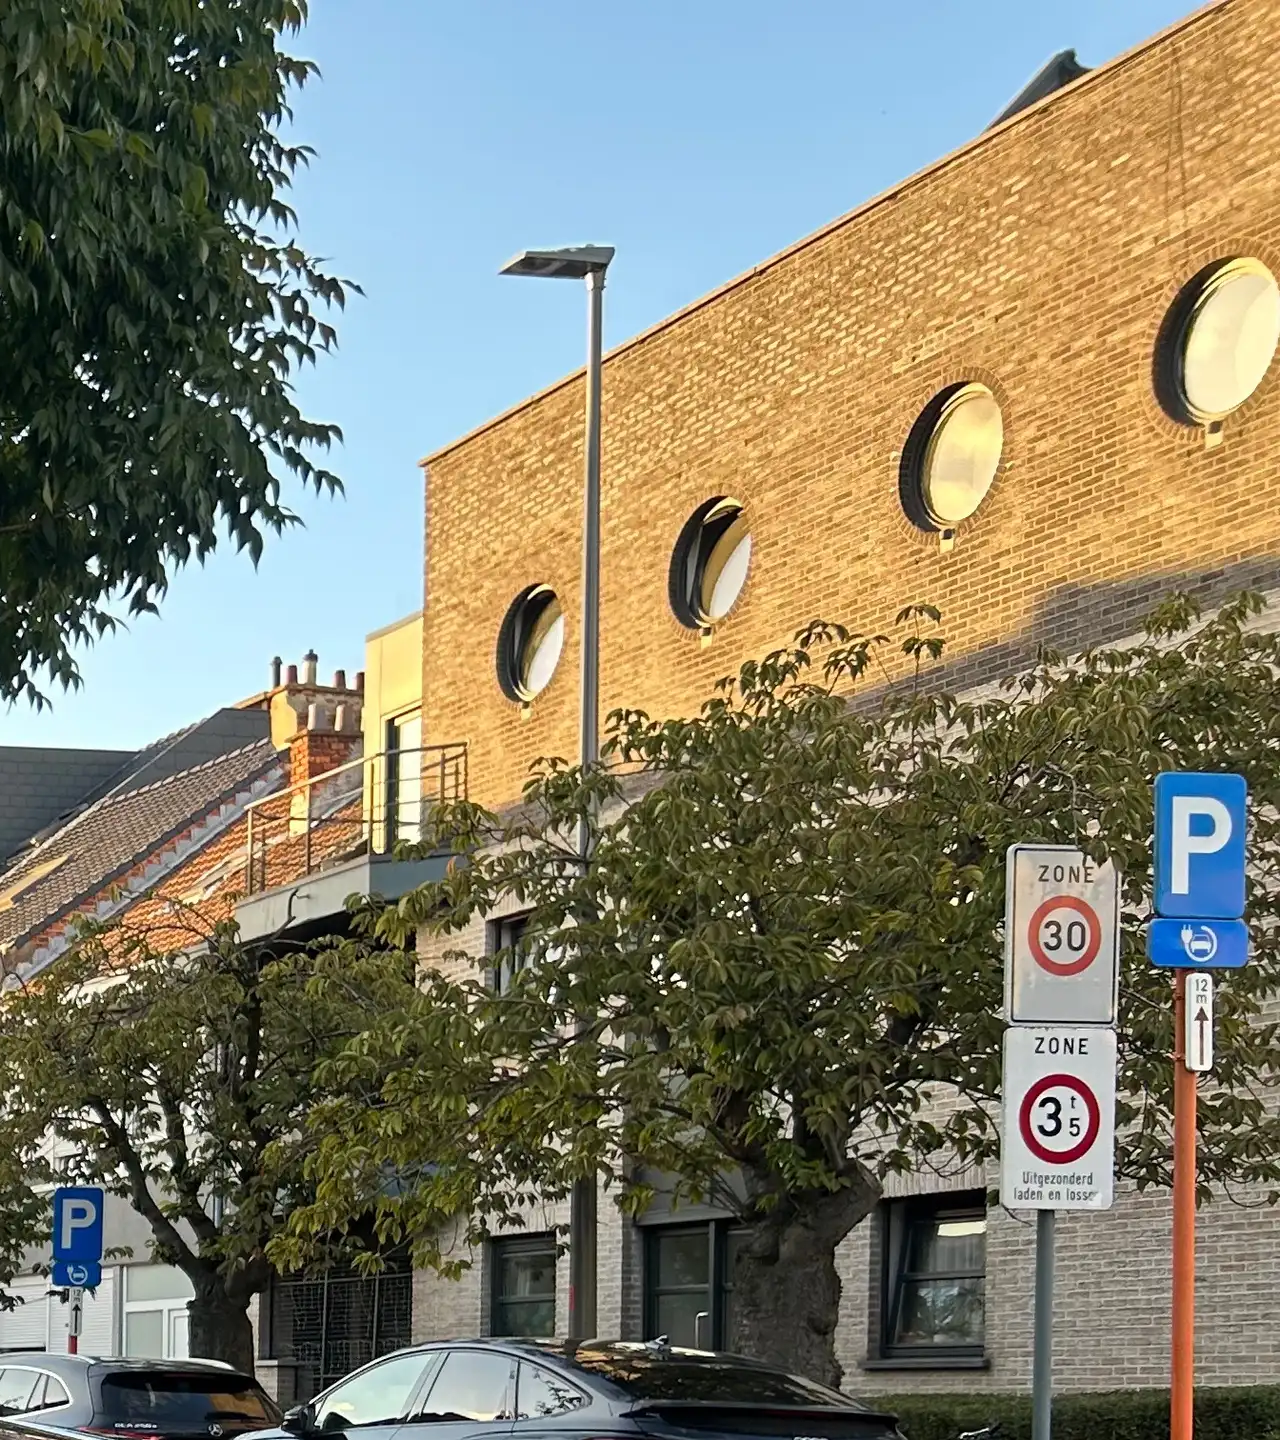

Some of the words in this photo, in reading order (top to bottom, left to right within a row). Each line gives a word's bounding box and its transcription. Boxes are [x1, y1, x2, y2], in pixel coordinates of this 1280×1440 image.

[1171, 796, 1232, 895] P
[1038, 865, 1095, 883] ZONE
[1044, 920, 1086, 952] 30
[1195, 978, 1208, 992] 12
[1196, 994, 1207, 1004] m
[1035, 1037, 1089, 1055] ZONE
[1022, 1171, 1094, 1188] Uitgezonderd
[1014, 1187, 1043, 1200] laden
[1048, 1190, 1061, 1200] en
[61, 1198, 96, 1249] P
